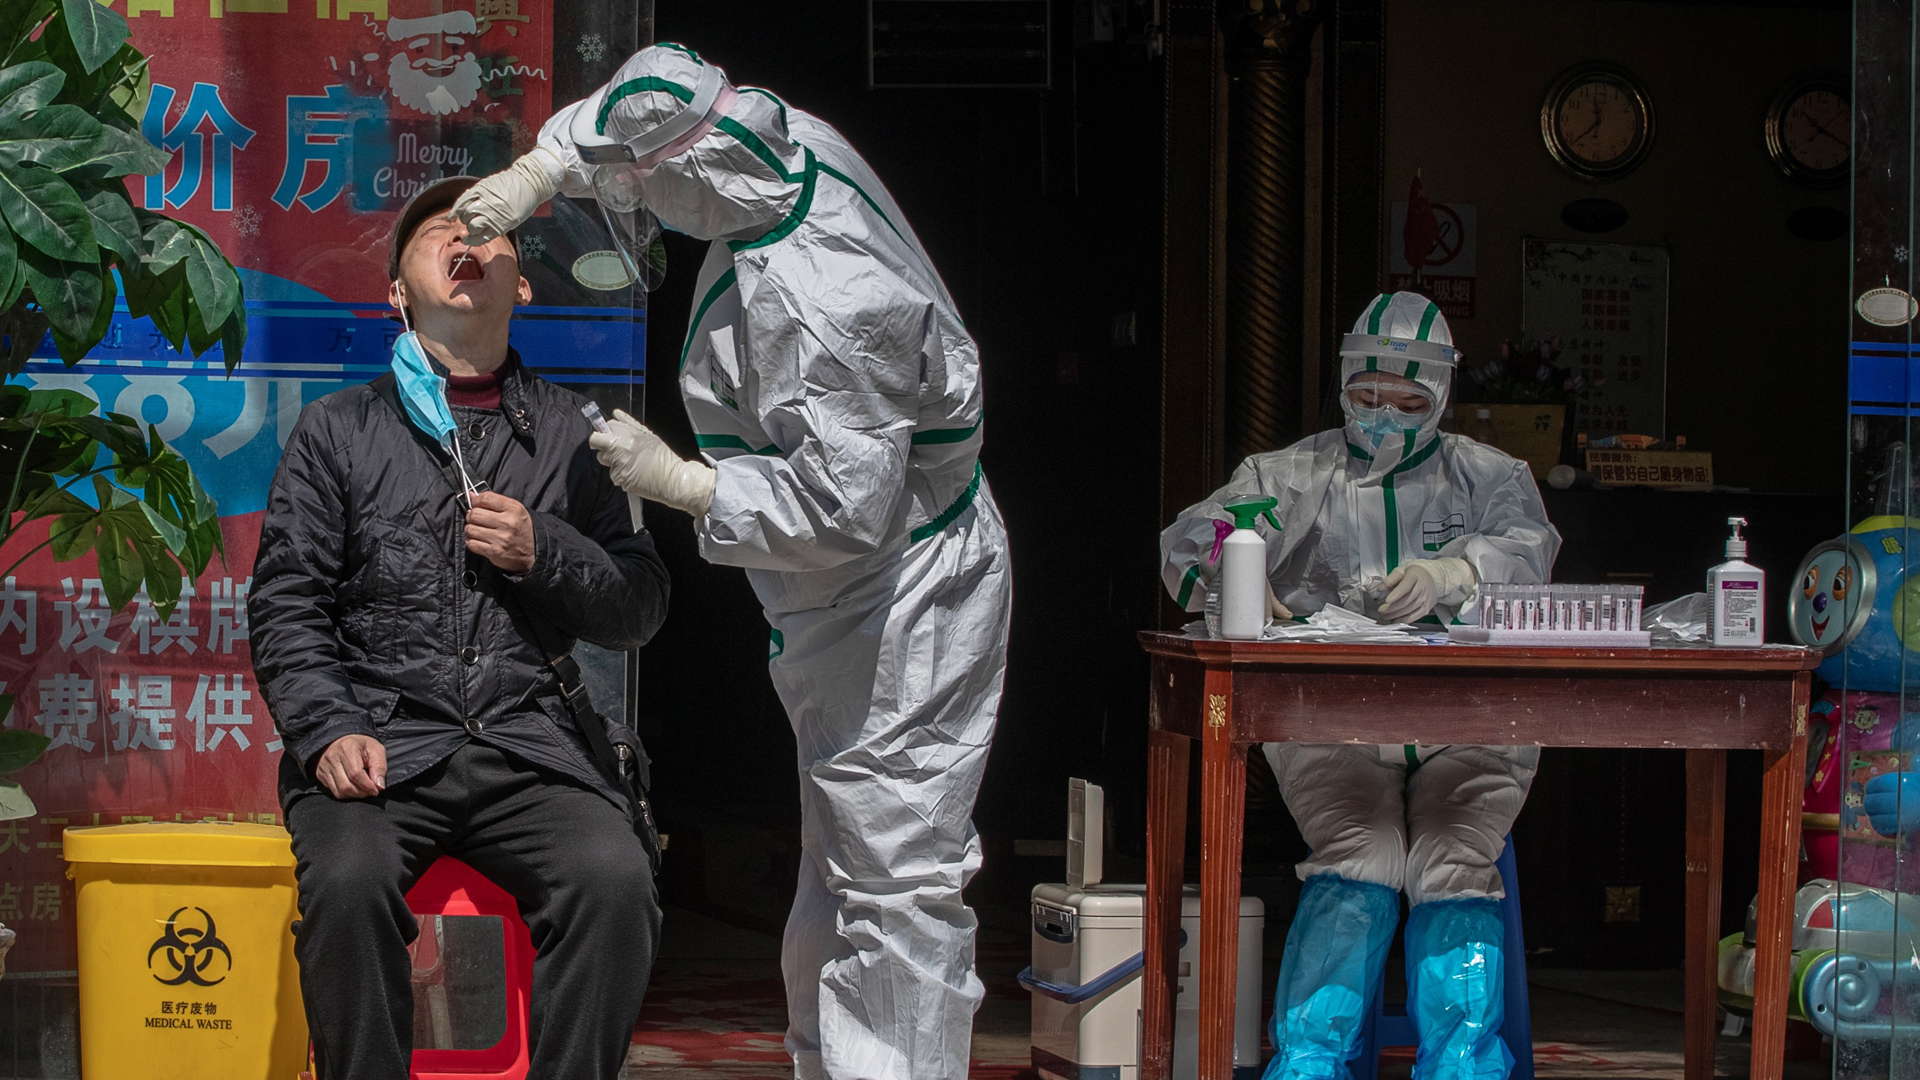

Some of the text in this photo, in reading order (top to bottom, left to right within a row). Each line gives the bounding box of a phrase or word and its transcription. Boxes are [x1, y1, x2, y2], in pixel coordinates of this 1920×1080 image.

[396, 132, 473, 176] Merry
[0, 673, 284, 753] 费提供
[161, 1001, 217, 1015] 医疗废物
[145, 1017, 232, 1030] MEDICAL WASTE
